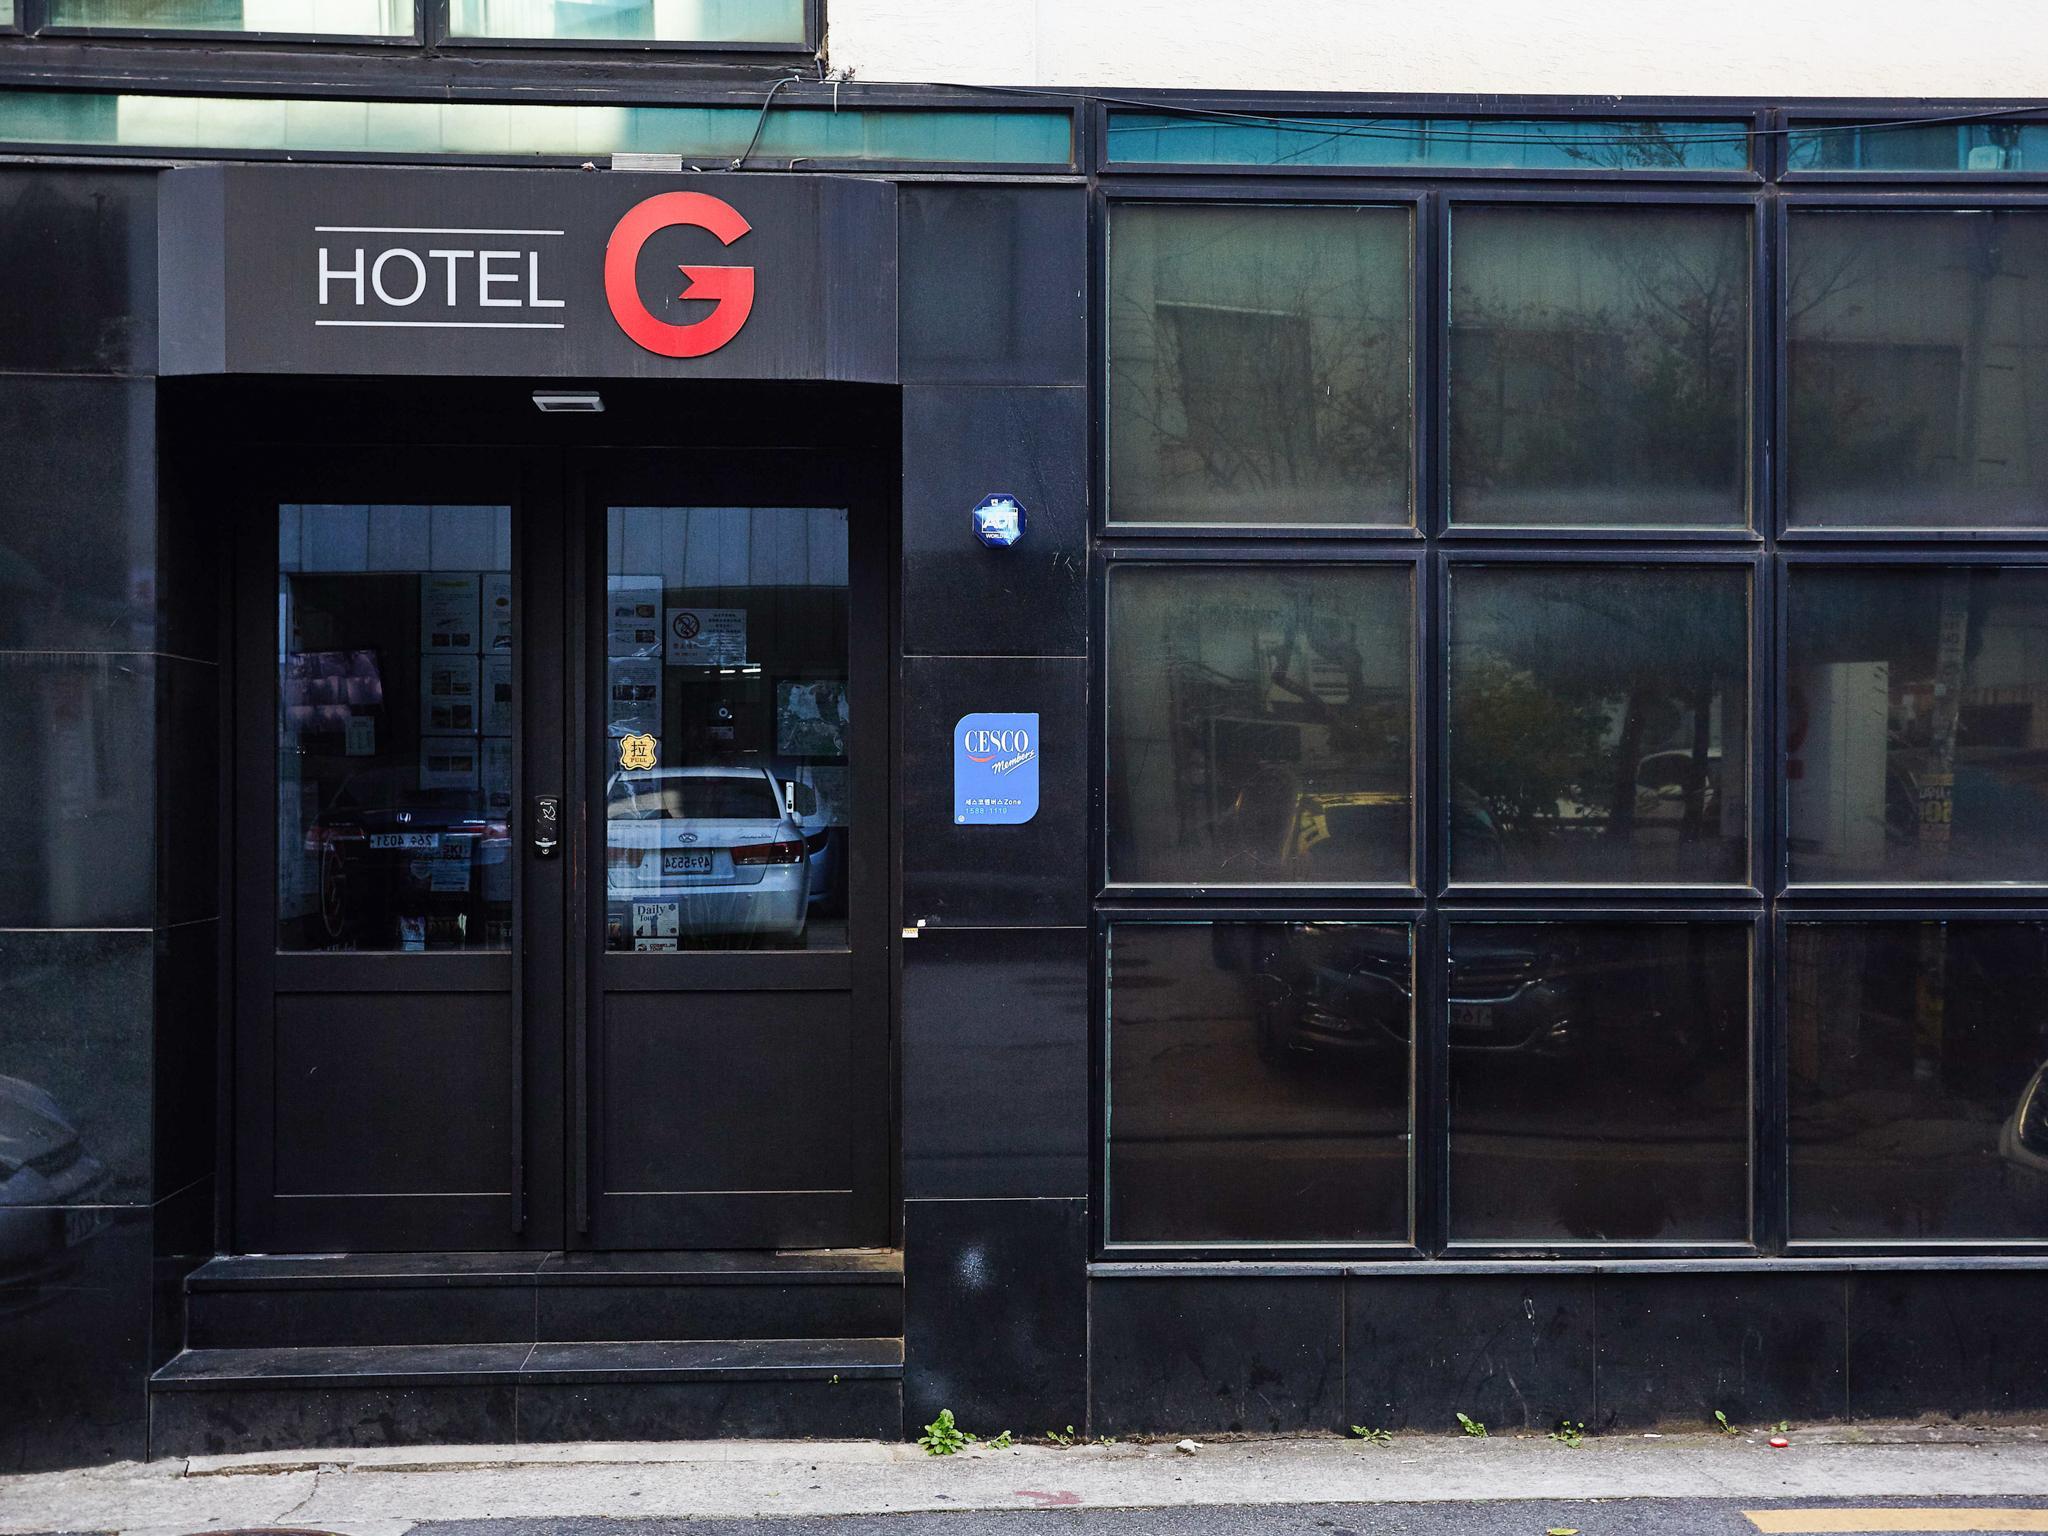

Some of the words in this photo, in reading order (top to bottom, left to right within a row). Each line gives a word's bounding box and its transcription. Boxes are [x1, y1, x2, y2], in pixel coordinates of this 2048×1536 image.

[318, 247, 566, 309] HOTEL
[604, 190, 755, 358] G
[630, 740, 647, 757] 拉
[963, 729, 1030, 753] CESCO
[991, 749, 1035, 775] Members
[637, 904, 666, 916] Daily
